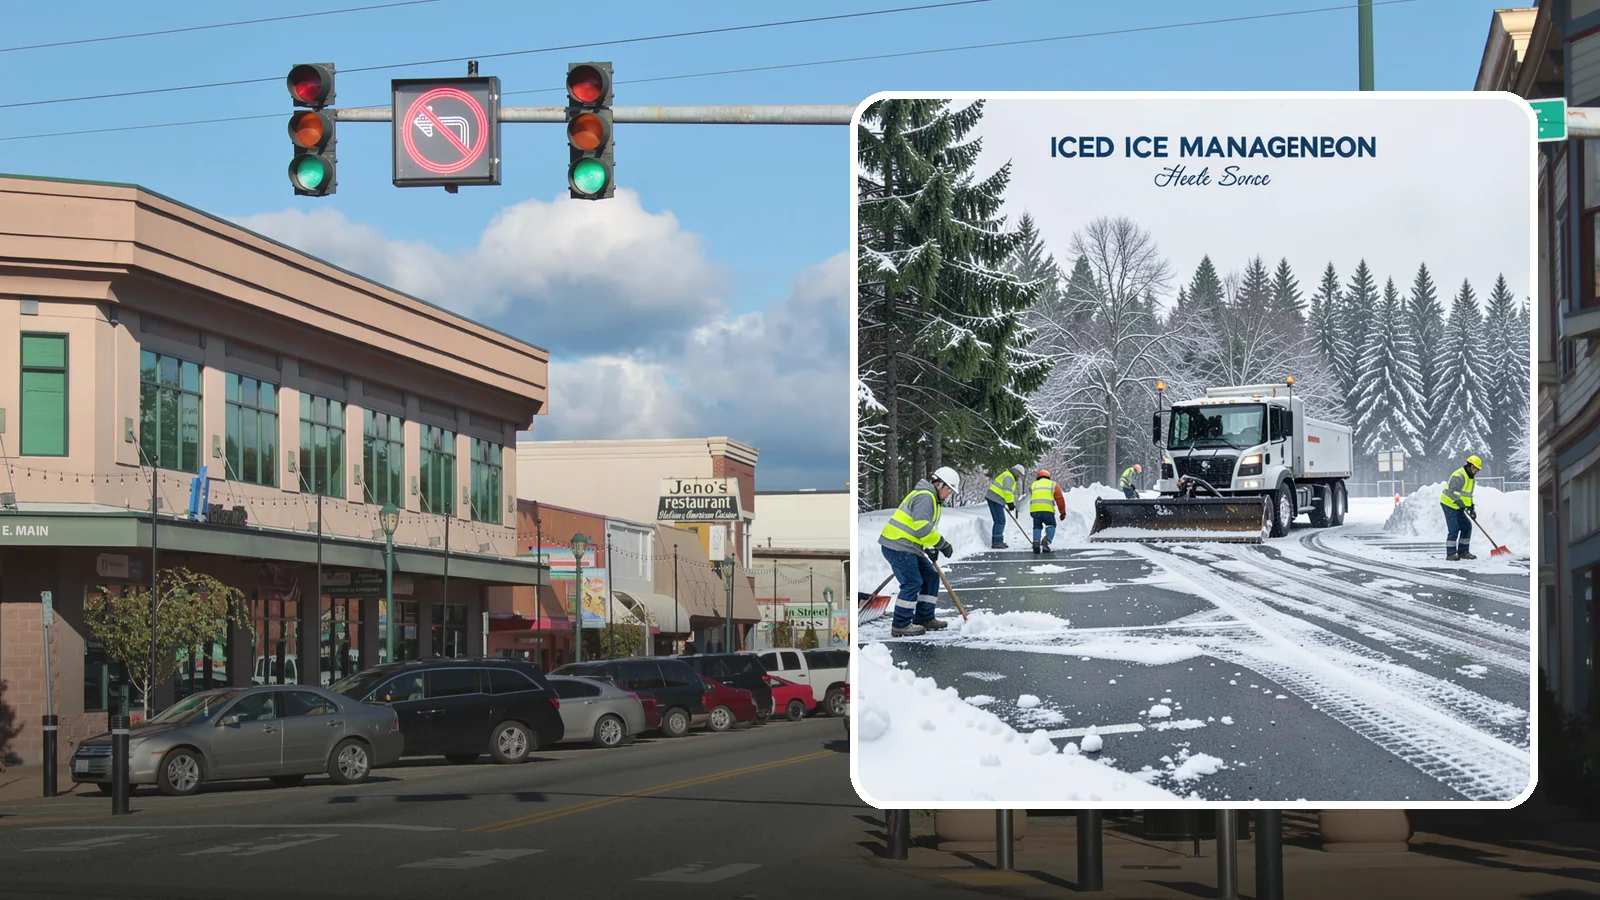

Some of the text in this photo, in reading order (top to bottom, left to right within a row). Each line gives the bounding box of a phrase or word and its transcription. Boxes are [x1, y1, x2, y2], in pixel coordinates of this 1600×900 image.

[670, 480, 727, 494] Jeno's
[665, 496, 731, 509] restaurant
[686, 510, 714, 519] American
[715, 510, 737, 519] Cuisine
[2, 525, 49, 536] E. MAIN
[797, 607, 828, 616] Street
[791, 619, 824, 627] lass
